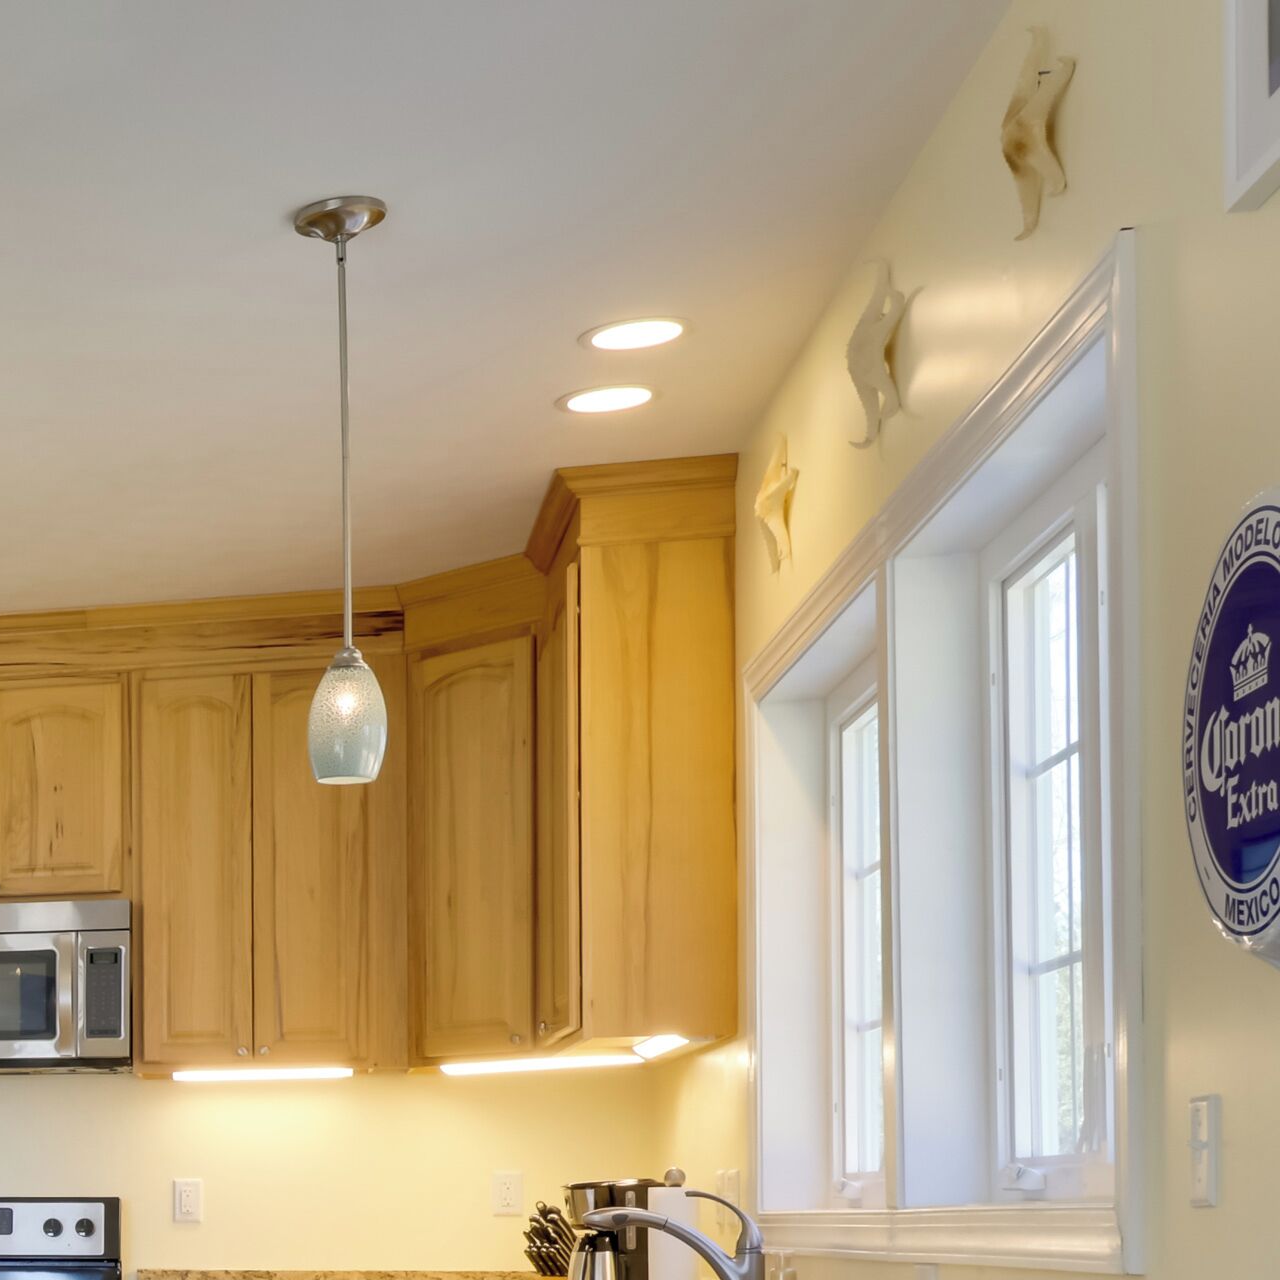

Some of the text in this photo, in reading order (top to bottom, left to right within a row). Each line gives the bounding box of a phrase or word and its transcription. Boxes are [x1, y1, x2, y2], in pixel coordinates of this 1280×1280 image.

[1185, 516, 1280, 823] CERVECERIA MODELO
[1201, 696, 1280, 797] Coron
[1226, 779, 1279, 830] Extra
[1225, 877, 1280, 926] MEXICO
